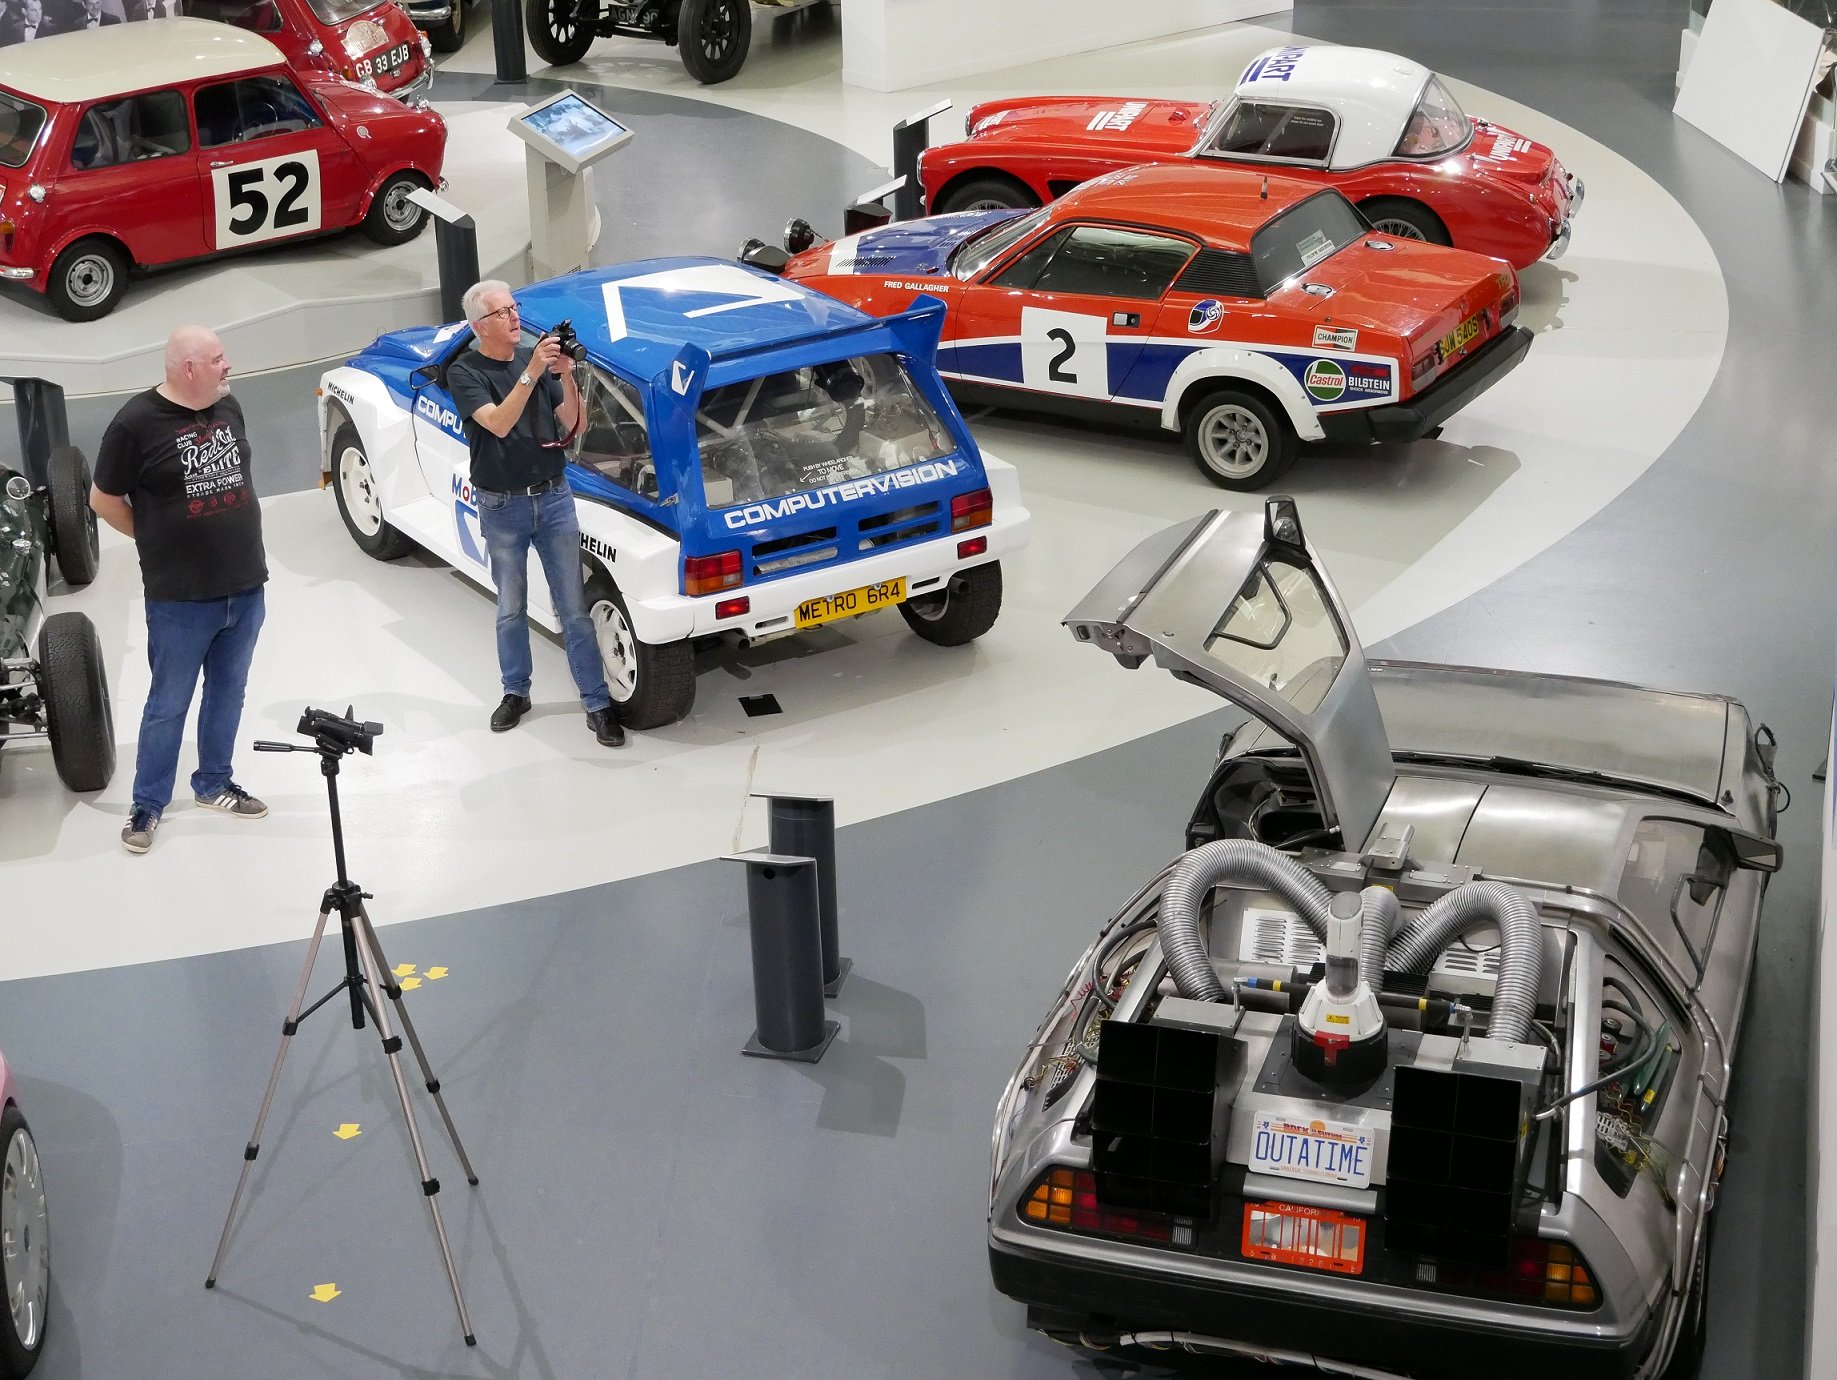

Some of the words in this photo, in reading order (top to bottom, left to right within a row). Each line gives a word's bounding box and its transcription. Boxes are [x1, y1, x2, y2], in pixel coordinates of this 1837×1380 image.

[356, 59, 372, 78] GB
[376, 55, 388, 73] 33
[391, 44, 409, 66] EJB
[228, 161, 309, 235] 52
[884, 281, 902, 289] FRED
[905, 282, 949, 293] GALLAGHER
[1317, 332, 1353, 344] CHAMPION
[1046, 328, 1077, 384] 2
[1309, 374, 1344, 386] Castrol
[1348, 376, 1390, 390] BILSTEIN
[327, 382, 355, 405] MICHELIN
[176, 431, 198, 443] RACING
[177, 440, 192, 449] CLUB
[203, 445, 241, 474] ELITE
[185, 481, 216, 494] EXTRA
[217, 473, 244, 487] POWER
[723, 459, 959, 530] COMPUTERVISION
[579, 531, 617, 563] HELIN
[799, 593, 857, 623] METRO
[867, 582, 900, 605] 6R4
[1255, 1131, 1368, 1176] OUTATIME
